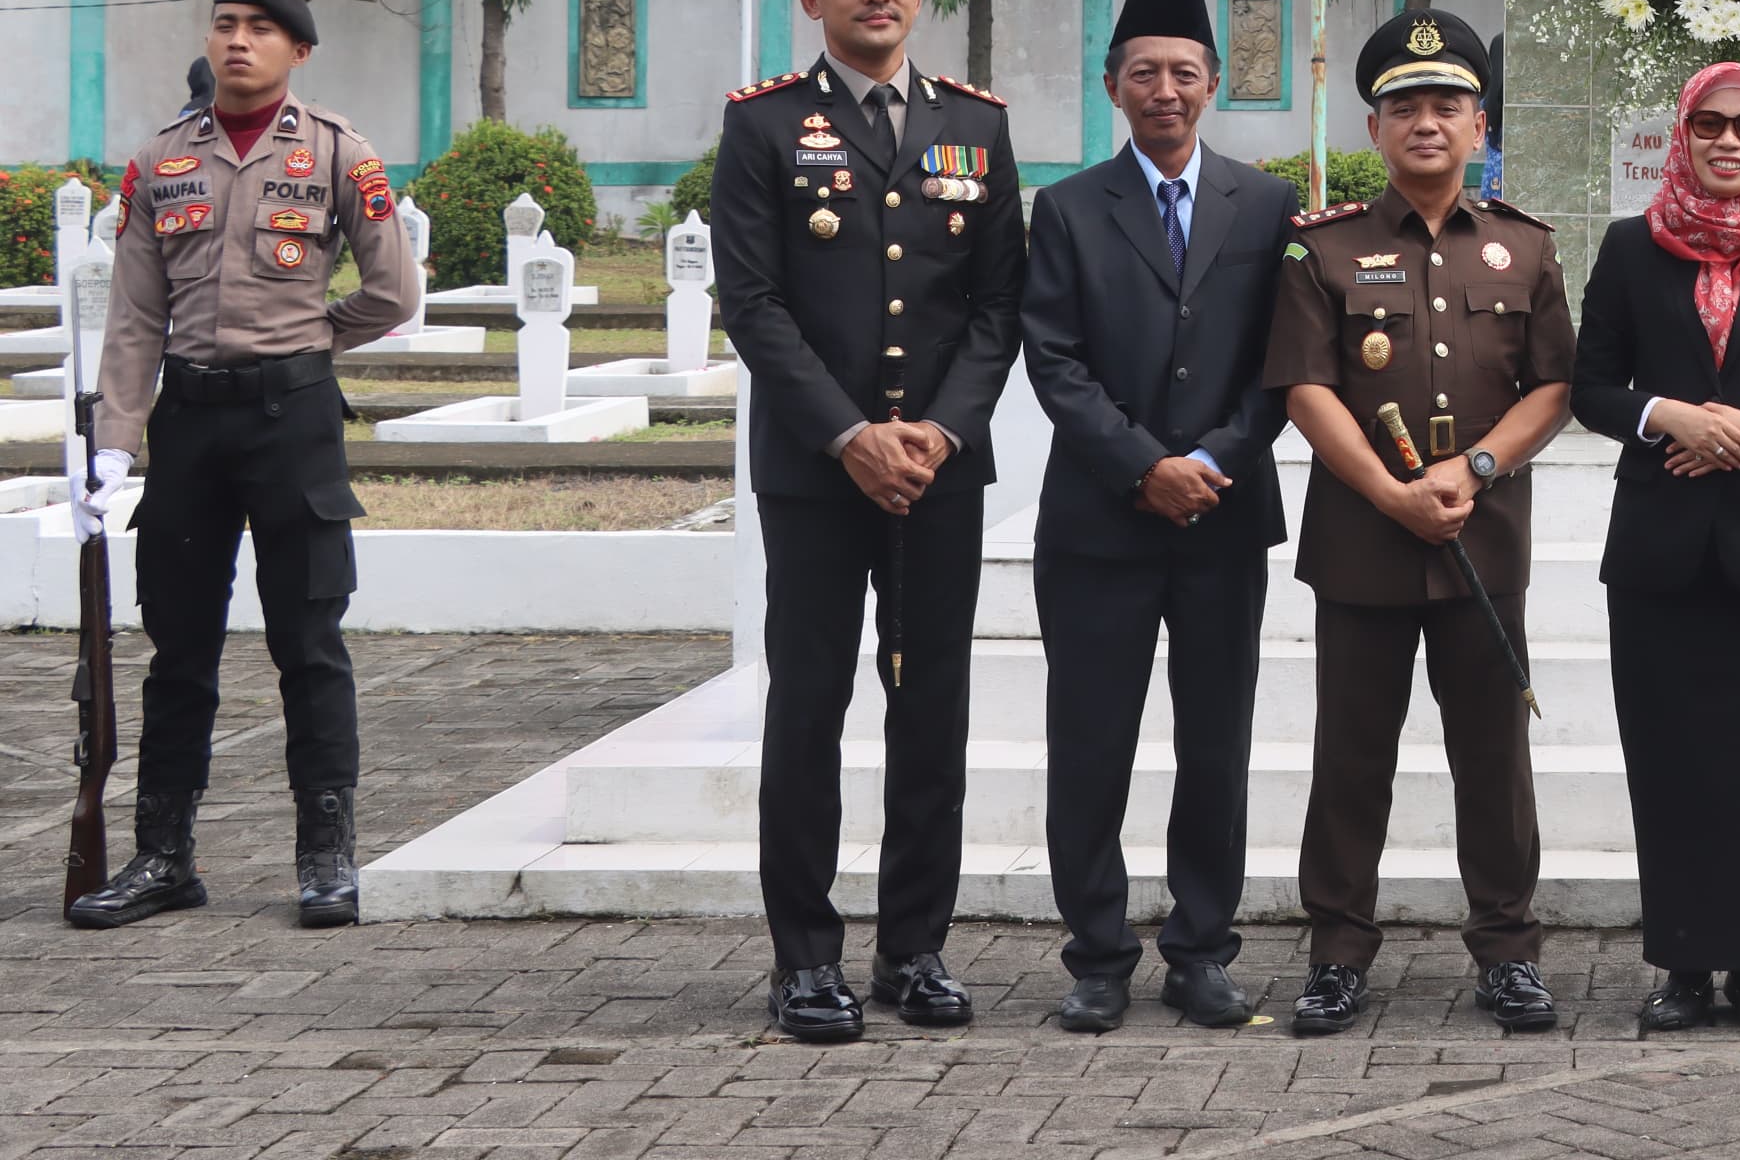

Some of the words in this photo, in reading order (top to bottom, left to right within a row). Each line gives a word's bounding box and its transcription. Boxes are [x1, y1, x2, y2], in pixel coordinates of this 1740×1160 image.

[1631, 132, 1662, 150] AKU
[816, 153, 843, 161] CAHYA
[152, 182, 206, 202] NAUFAL
[262, 181, 328, 203] POLRI
